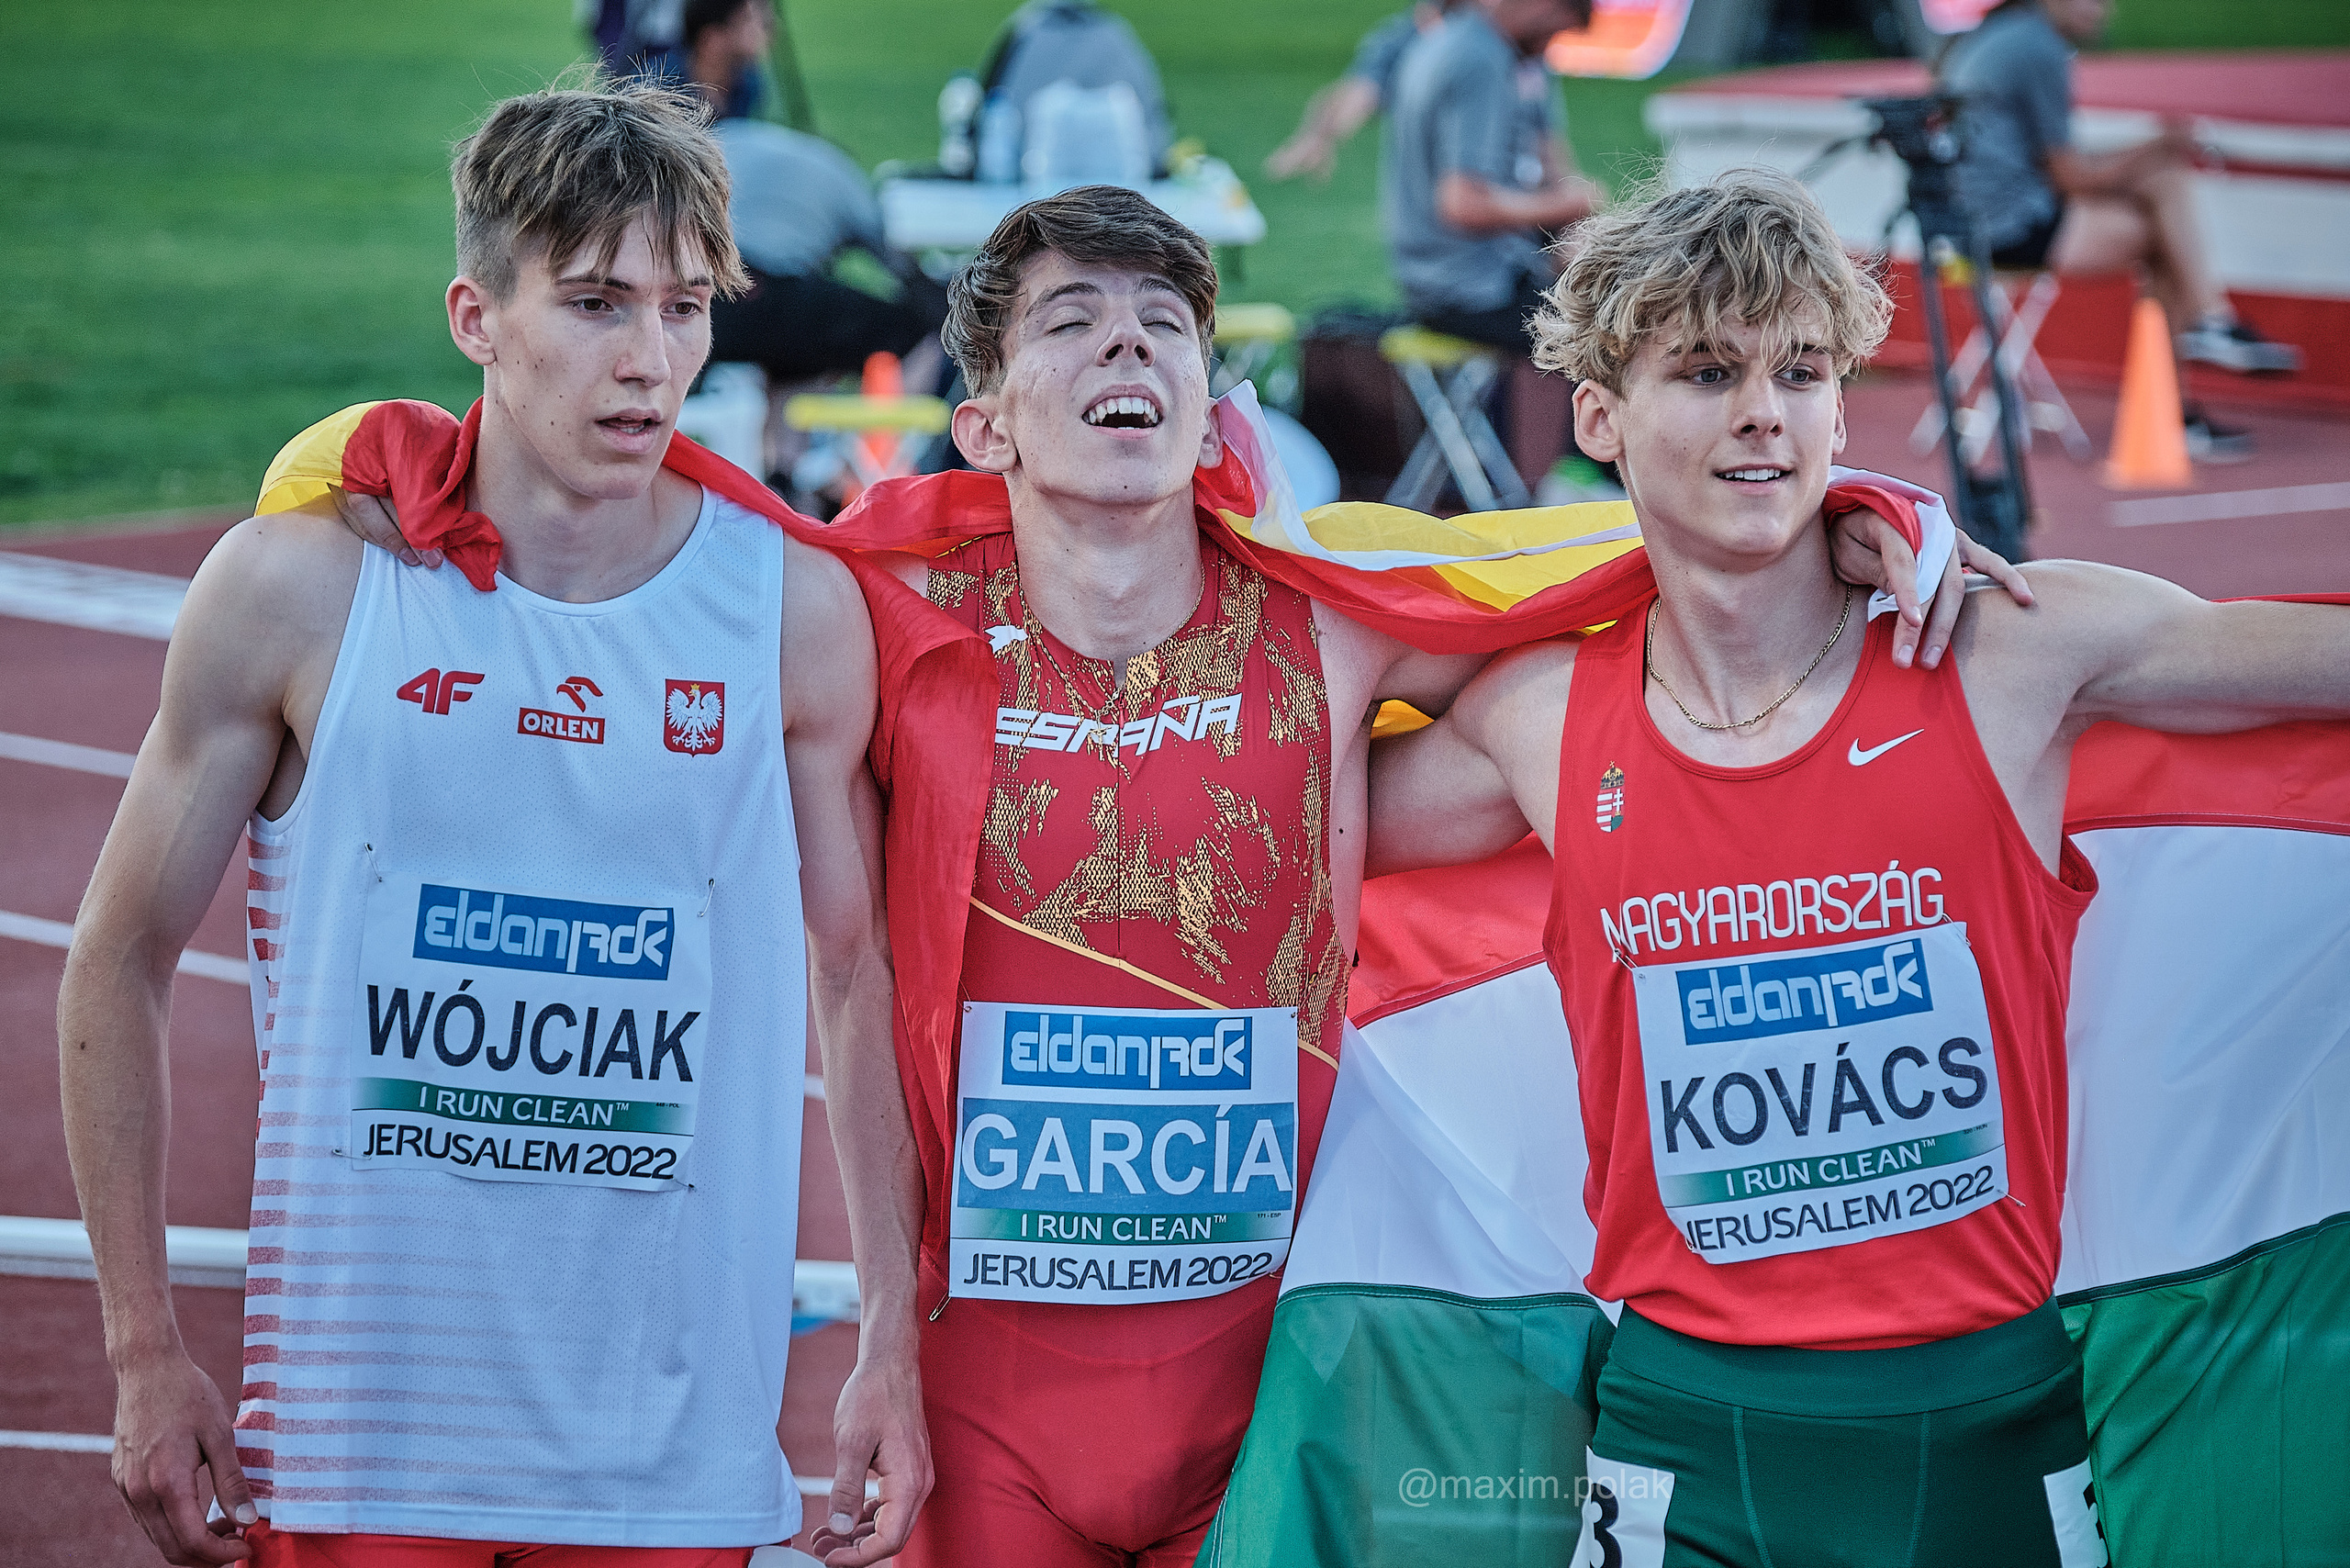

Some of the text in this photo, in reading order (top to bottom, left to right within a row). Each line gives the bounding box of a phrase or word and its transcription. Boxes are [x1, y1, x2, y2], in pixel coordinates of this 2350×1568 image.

[397, 668, 485, 715] 4F
[522, 712, 599, 740] ORLEN
[995, 693, 1242, 757] ESPAÑA
[366, 980, 701, 1082] WÓJCIAK
[420, 1086, 427, 1108] I
[436, 1089, 504, 1119] RUN
[1661, 1042, 1988, 1153] KOVÁCS
[363, 1124, 677, 1180] JERUSALEM 2022
[961, 1103, 1292, 1194] GARCÍA
[1726, 1173, 1735, 1196] I
[1744, 1161, 1810, 1194] RUN
[1907, 1165, 1995, 1217] 2022
[1021, 1213, 1028, 1238] I
[1037, 1214, 1102, 1240] RUN
[963, 1252, 1273, 1291] JERUSALEM 2022
